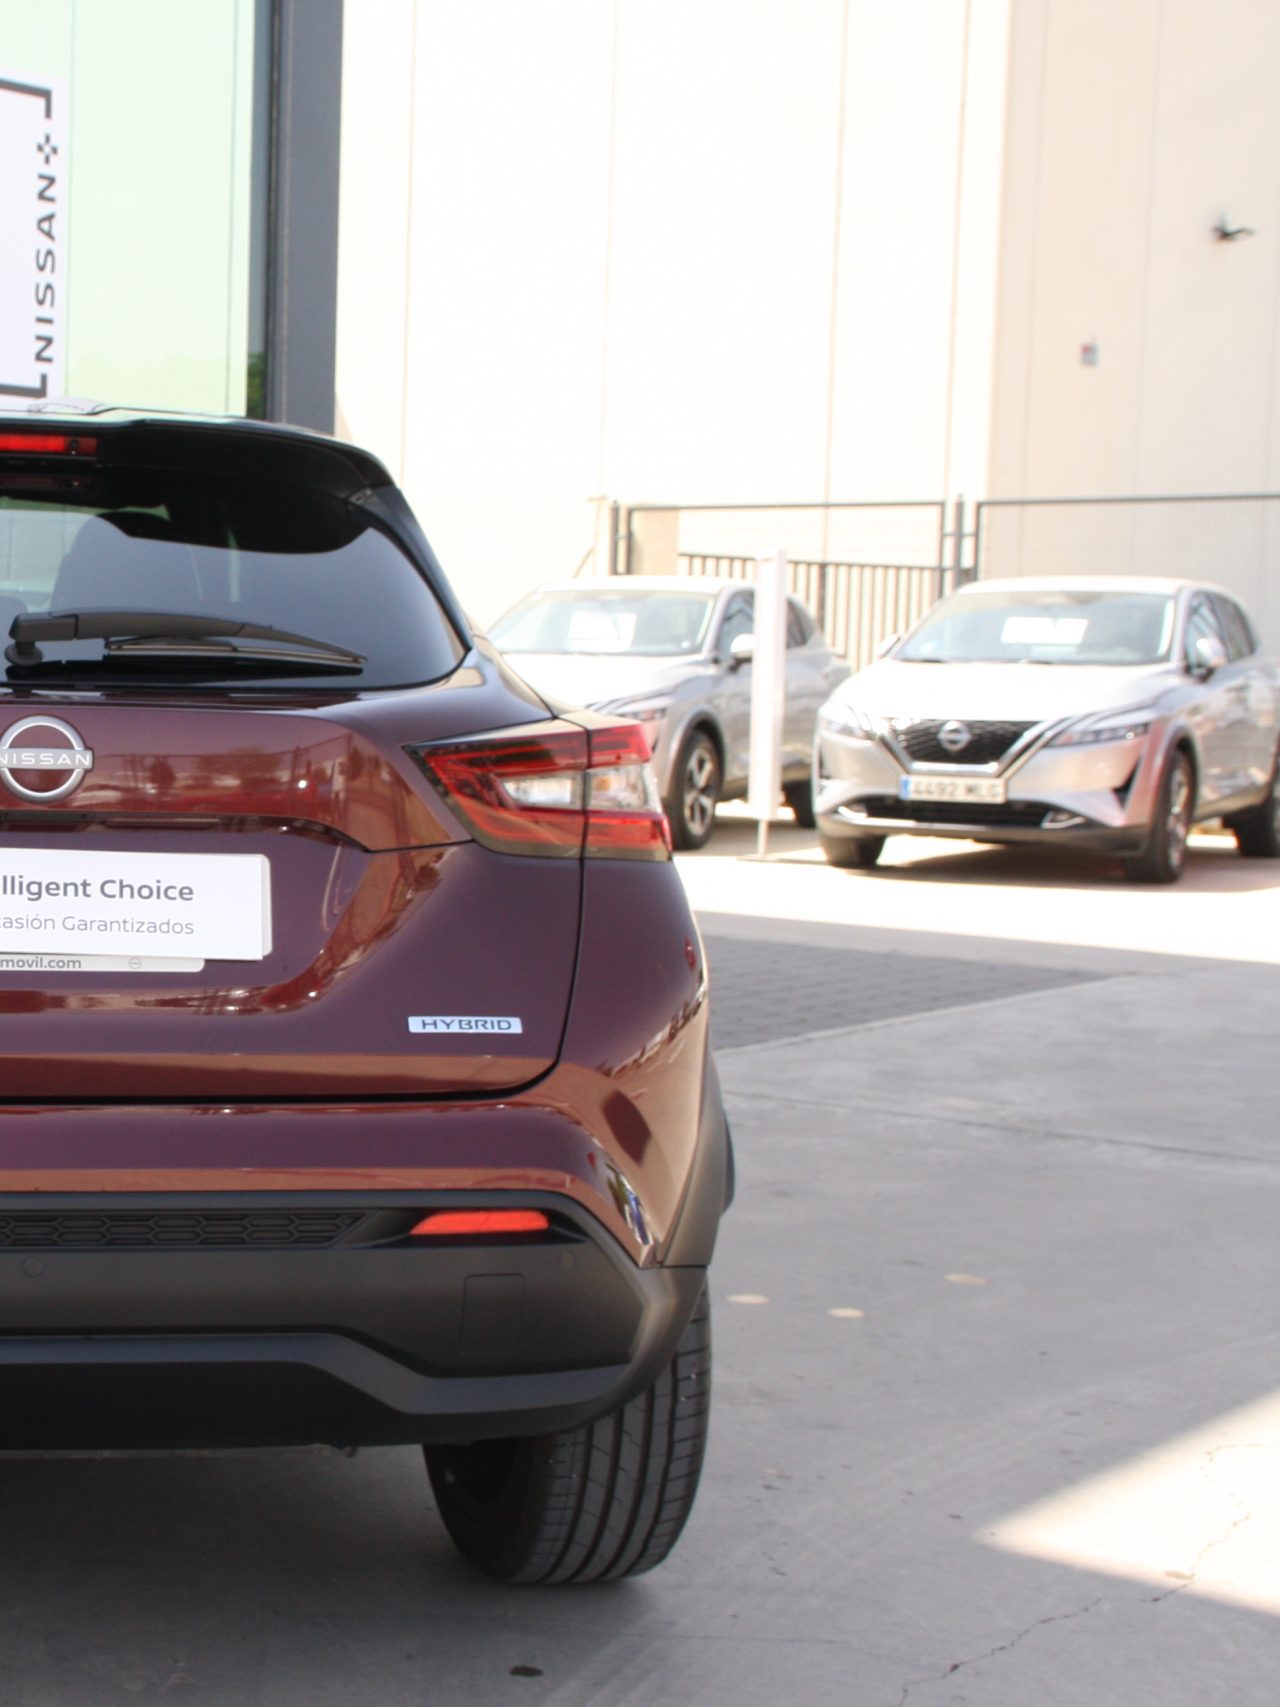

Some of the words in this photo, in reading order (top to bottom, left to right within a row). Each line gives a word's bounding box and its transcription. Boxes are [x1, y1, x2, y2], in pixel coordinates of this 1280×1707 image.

[34, 173, 56, 363] NISSAN
[99, 879, 194, 902] Choice
[62, 915, 194, 935] Garantizados
[421, 1019, 512, 1031] HYBRID
